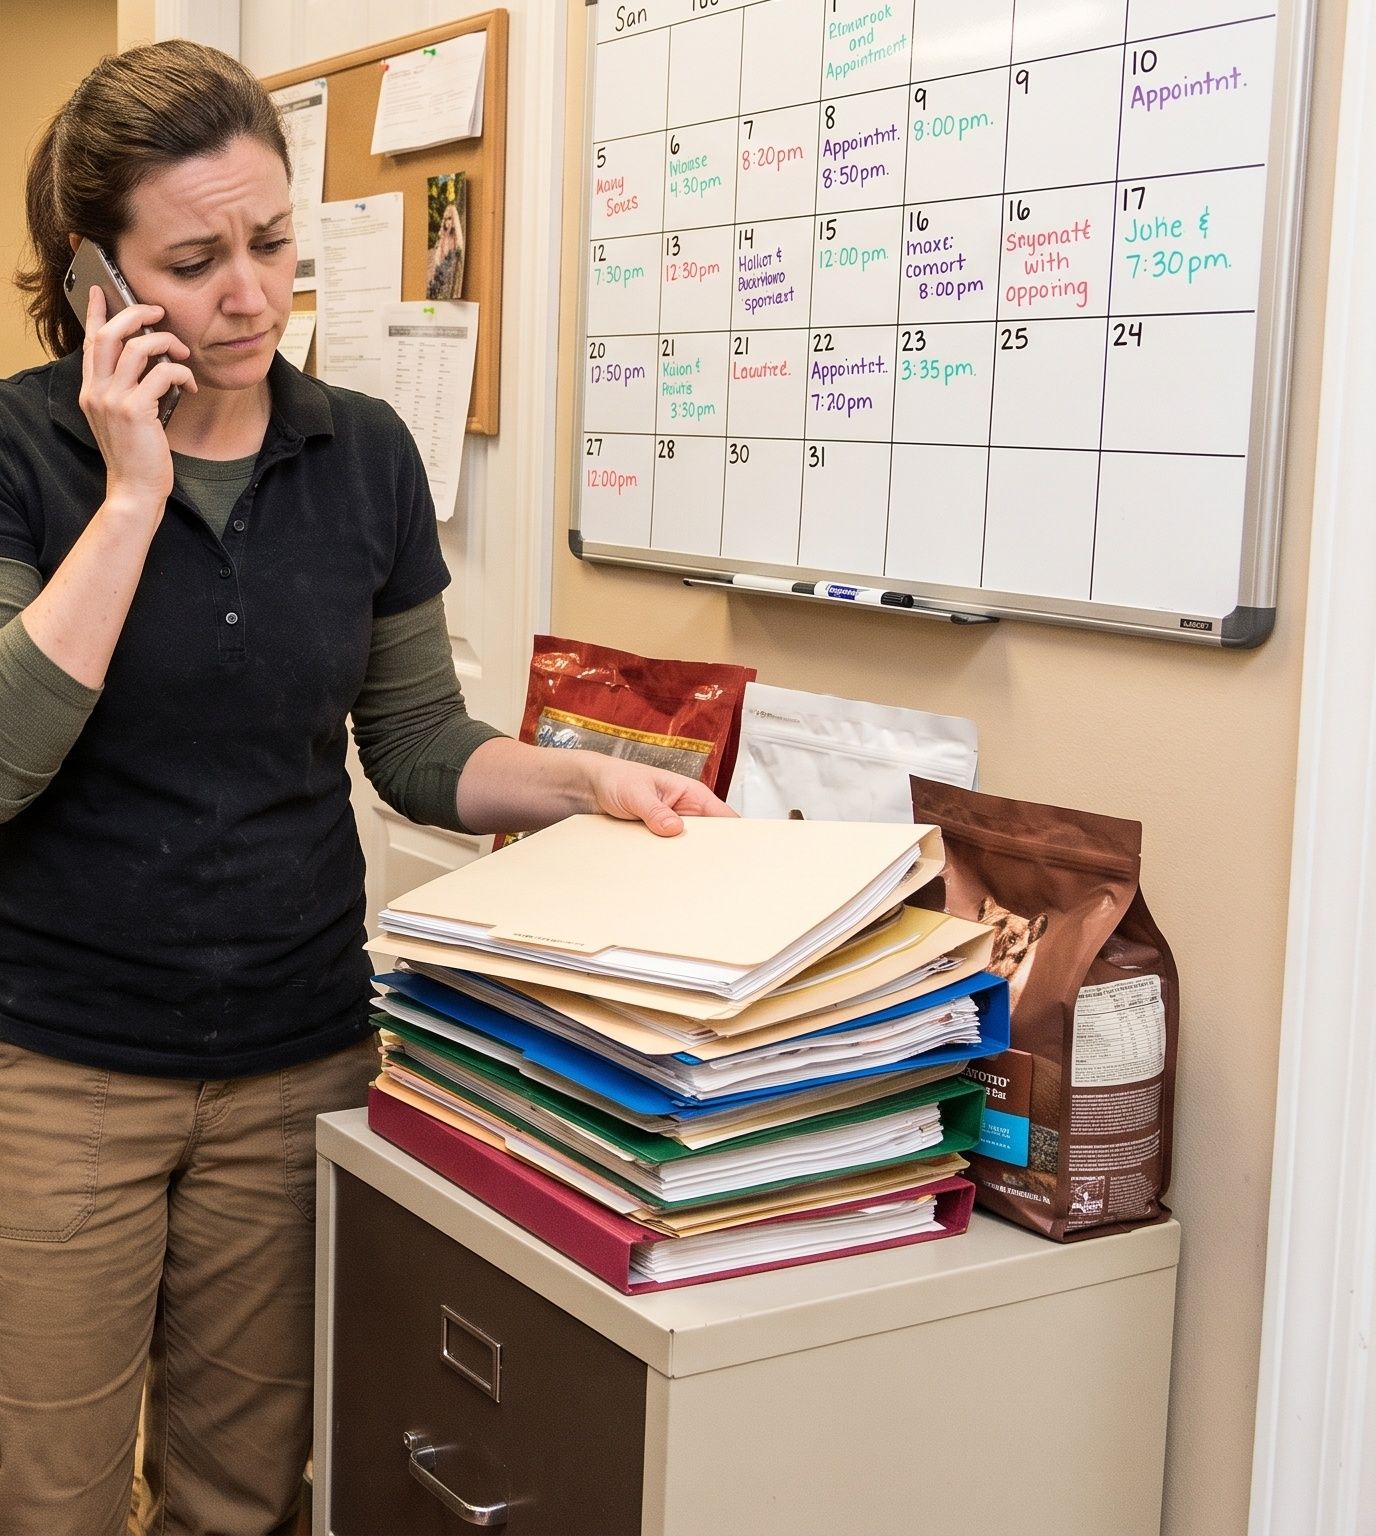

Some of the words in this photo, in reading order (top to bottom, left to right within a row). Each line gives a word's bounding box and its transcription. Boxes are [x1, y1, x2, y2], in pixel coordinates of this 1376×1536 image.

[1132, 49, 1158, 76] 10
[1015, 69, 1030, 95] 9
[914, 87, 927, 111] 9
[824, 105, 836, 130] 8
[743, 120, 754, 140] 7
[670, 135, 681, 156] 6
[596, 147, 607, 169] 5
[1123, 186, 1146, 211] 17
[909, 210, 929, 233] 16
[1009, 199, 1031, 222] 16
[738, 228, 755, 250] 14
[819, 219, 837, 241] 15
[593, 244, 607, 263] 12
[666, 235, 682, 257] 13
[1024, 251, 1070, 276] with
[733, 336, 750, 356] 21
[813, 333, 835, 353] 22
[901, 330, 927, 352] 23
[1000, 327, 1029, 351] 25
[1113, 322, 1143, 348] 24
[589, 342, 606, 360] 20
[661, 338, 675, 357] 21
[586, 438, 603, 457] 27
[657, 439, 675, 460] 28
[728, 444, 750, 464] 30
[807, 446, 826, 468] 31
